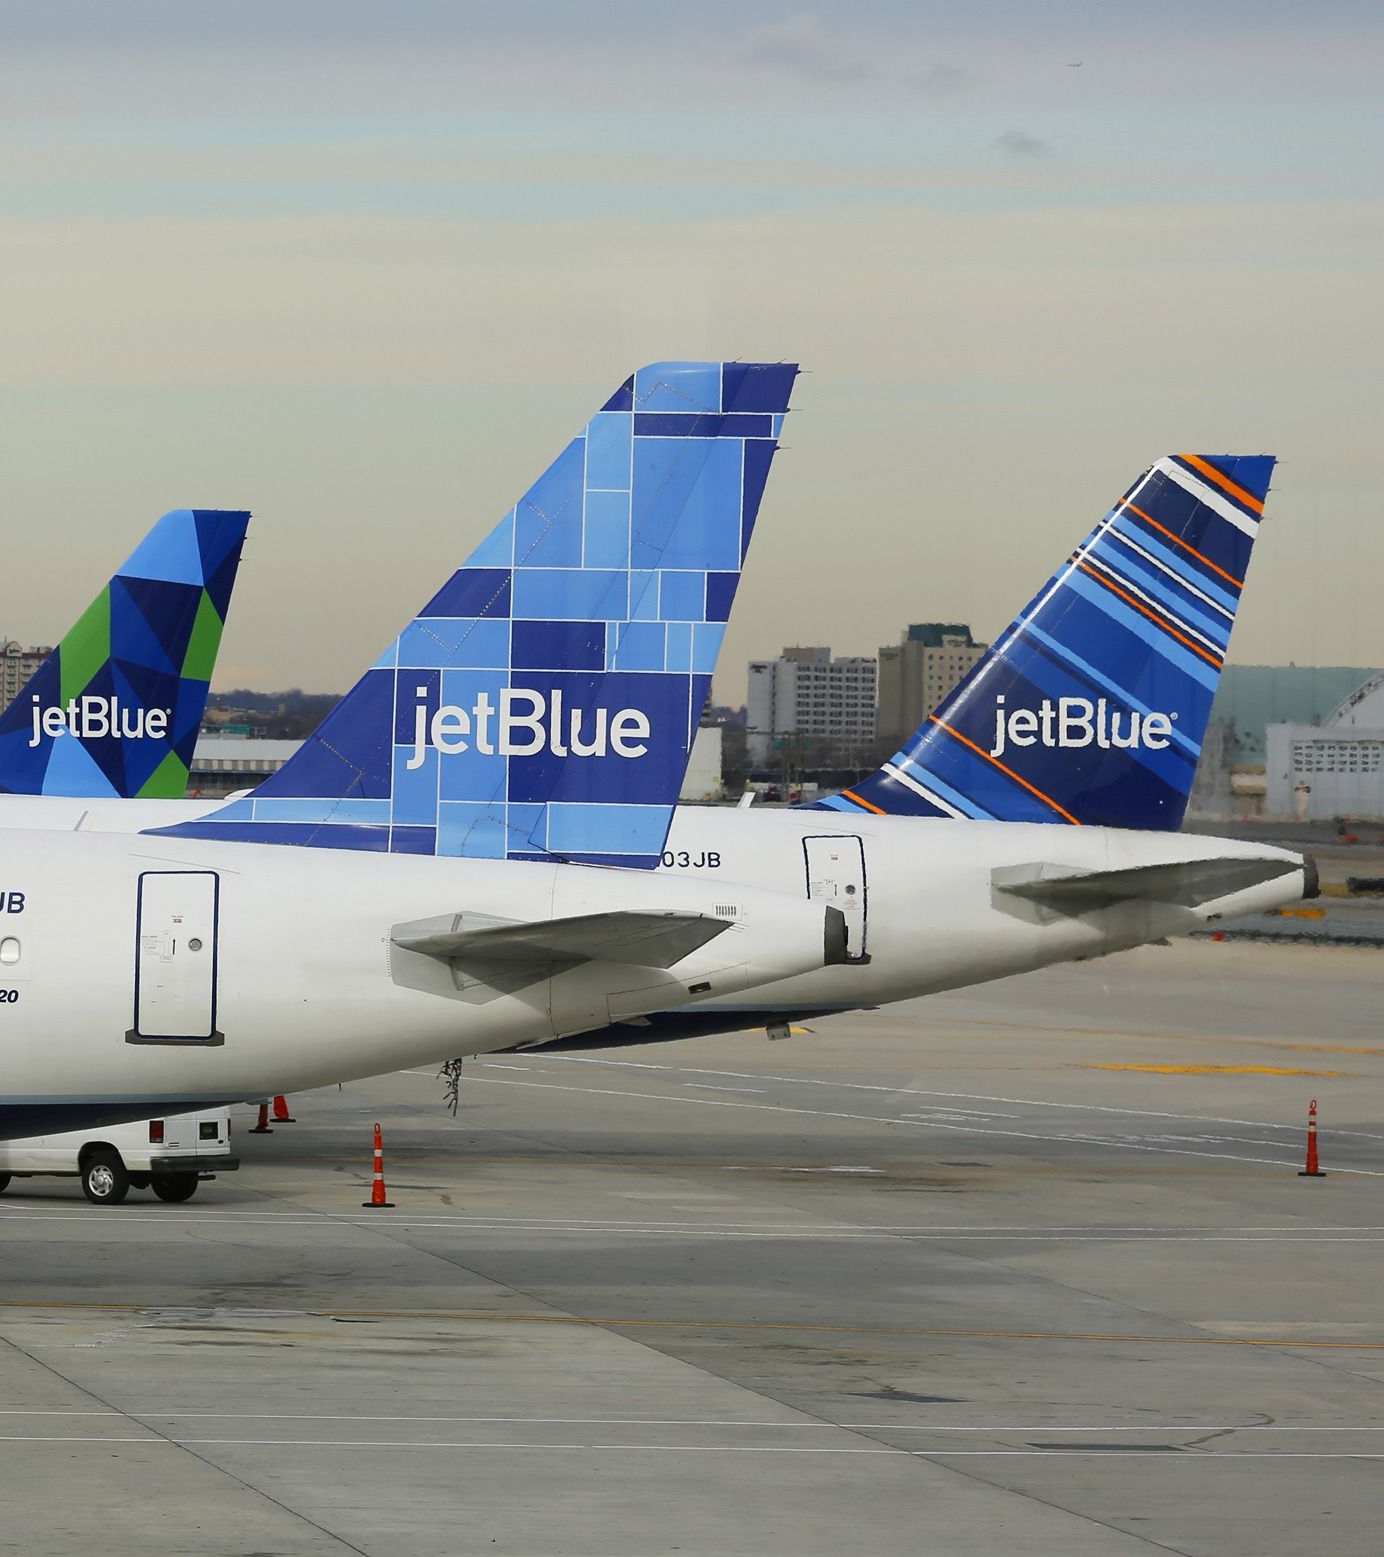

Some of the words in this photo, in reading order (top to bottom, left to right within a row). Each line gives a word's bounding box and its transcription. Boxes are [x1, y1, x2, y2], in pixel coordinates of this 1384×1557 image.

[29, 694, 169, 747] jetBlue
[406, 686, 650, 770] jetBlue
[990, 695, 1172, 758] jetBlue
